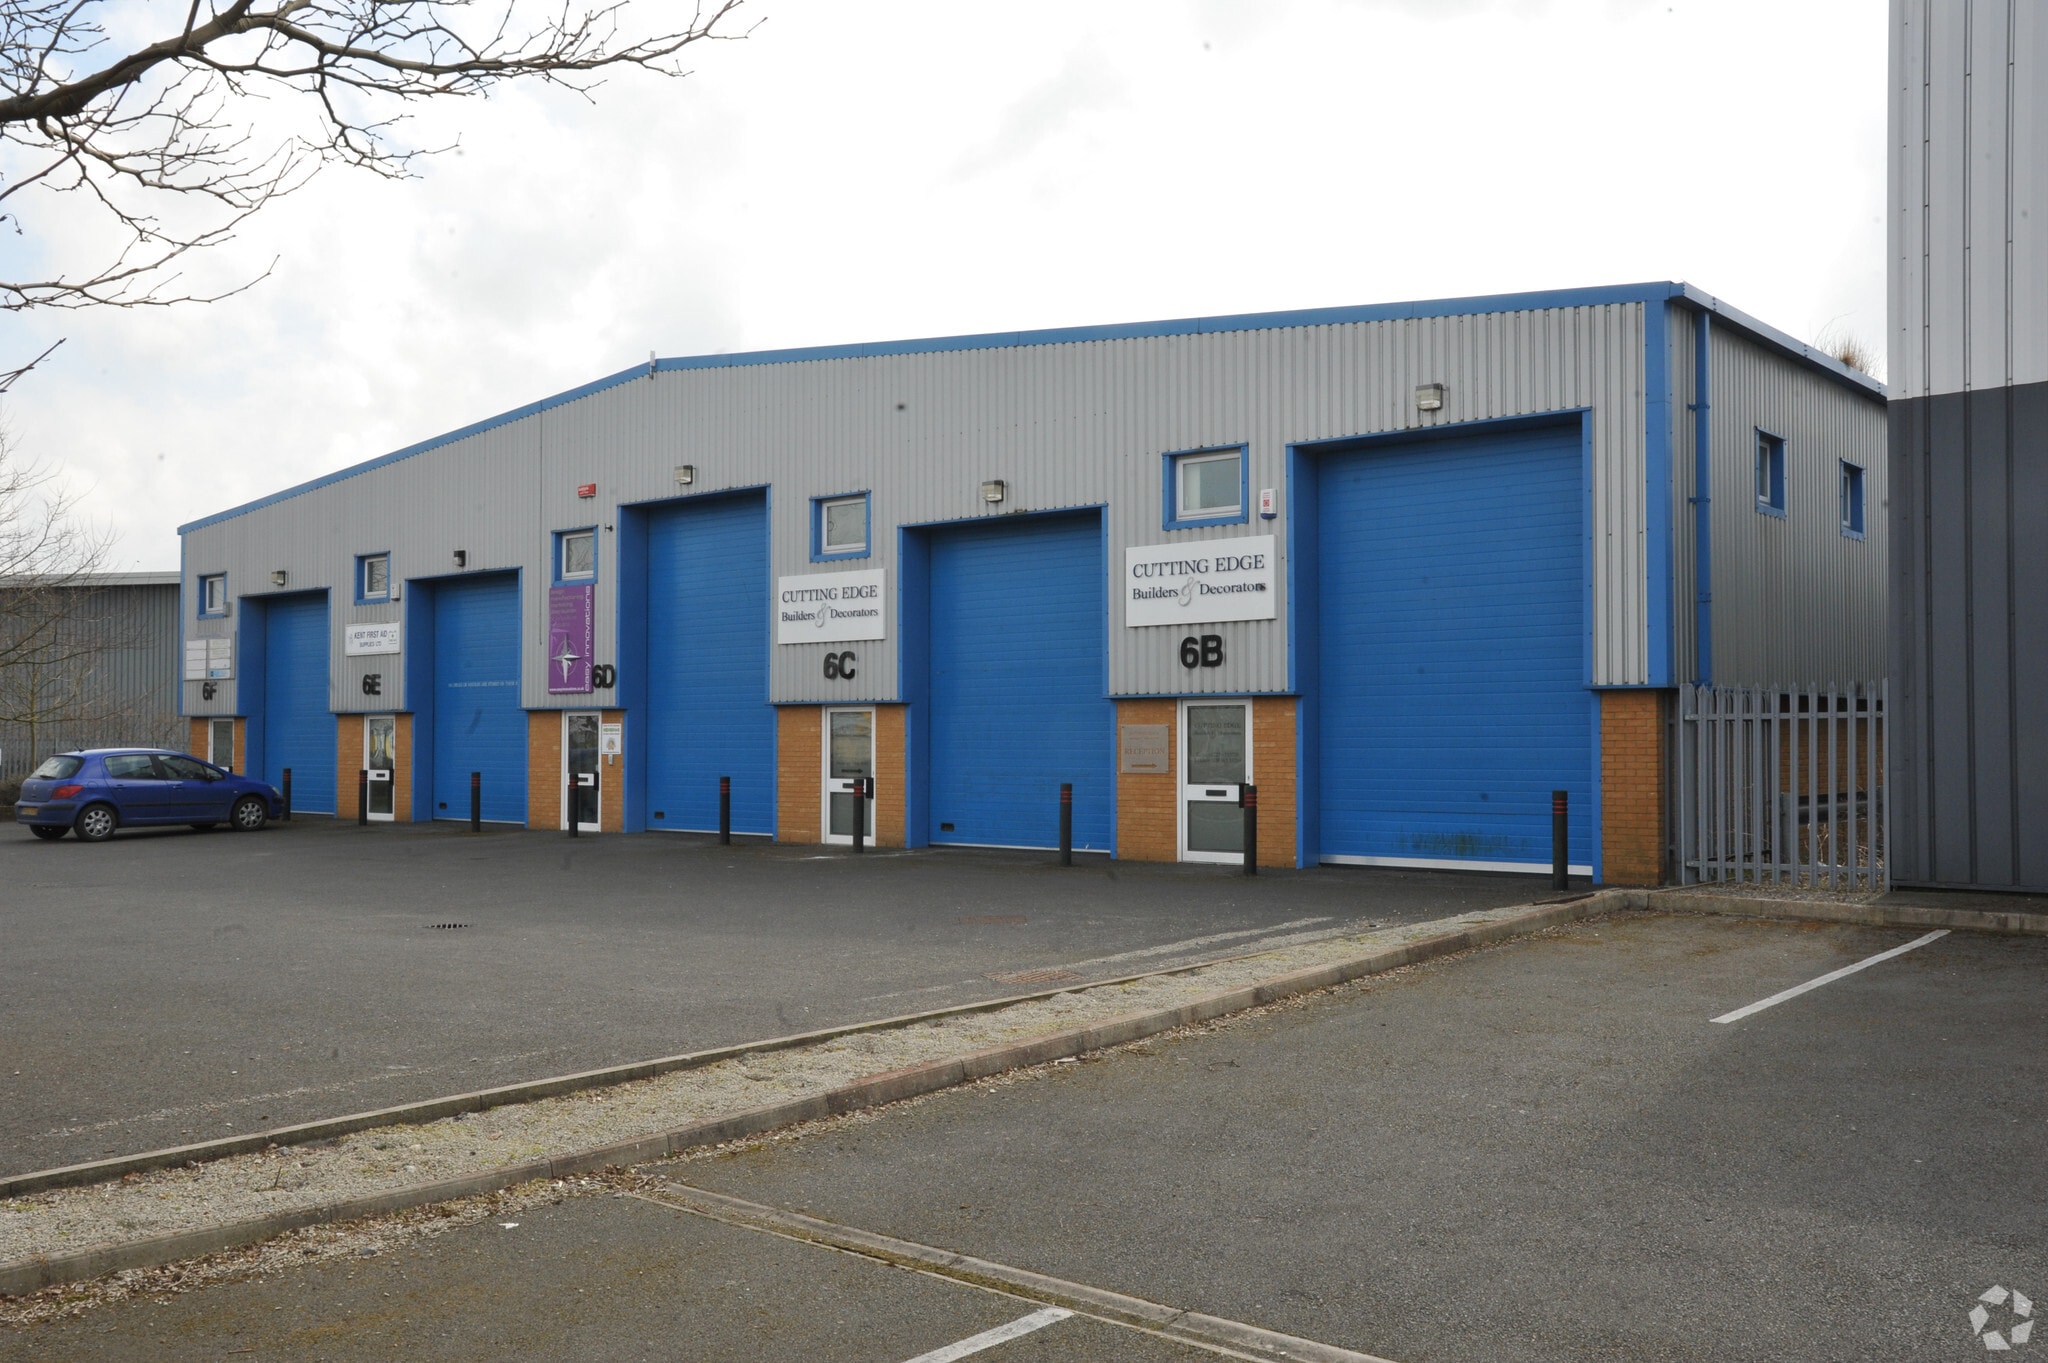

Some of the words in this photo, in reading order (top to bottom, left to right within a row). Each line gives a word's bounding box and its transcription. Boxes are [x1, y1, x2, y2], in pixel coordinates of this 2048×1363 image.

[1132, 558, 1209, 578] CUTTING
[1215, 554, 1265, 572] EDGE
[781, 587, 838, 603] CUTTING
[842, 585, 878, 599] EDGE
[1132, 587, 1179, 600] Builders
[1199, 582, 1267, 595] Decorators
[781, 611, 816, 622] Builders
[830, 608, 879, 619] Decorators
[354, 631, 366, 640] KENT
[366, 630, 380, 639] FIRST
[380, 629, 388, 638] AID
[1180, 634, 1224, 669] 6B
[823, 650, 856, 680] 6C
[362, 673, 382, 695] 6E
[593, 664, 615, 688] 6D
[202, 681, 217, 701] 6F
[1124, 747, 1165, 755] RECEPTION
